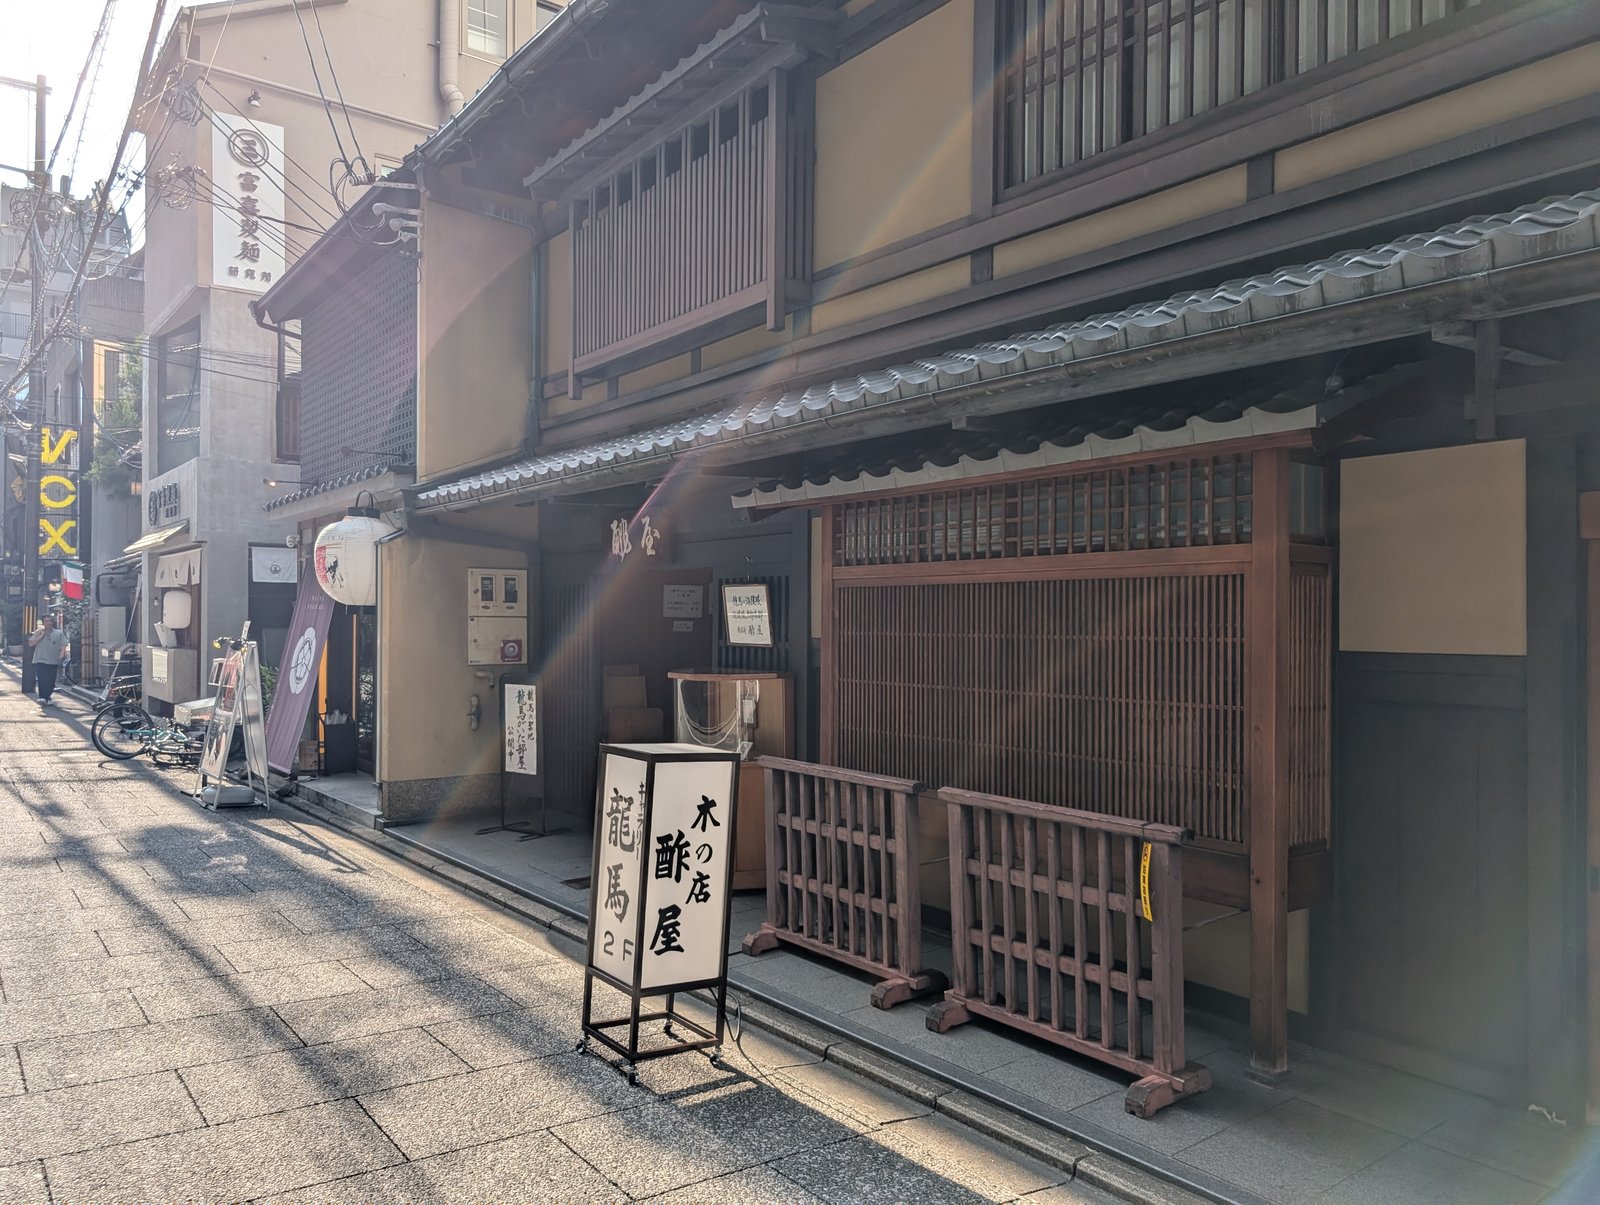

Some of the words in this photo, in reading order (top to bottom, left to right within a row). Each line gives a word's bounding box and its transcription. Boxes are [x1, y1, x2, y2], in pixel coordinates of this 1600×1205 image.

[507, 725, 515, 761] 公開中
[515, 688, 528, 771] 龍馬がいた部屋
[604, 787, 636, 924] 龍馬
[649, 829, 692, 957] 酢屋
[685, 794, 721, 905] 木の店
[603, 930, 635, 962] 2F
